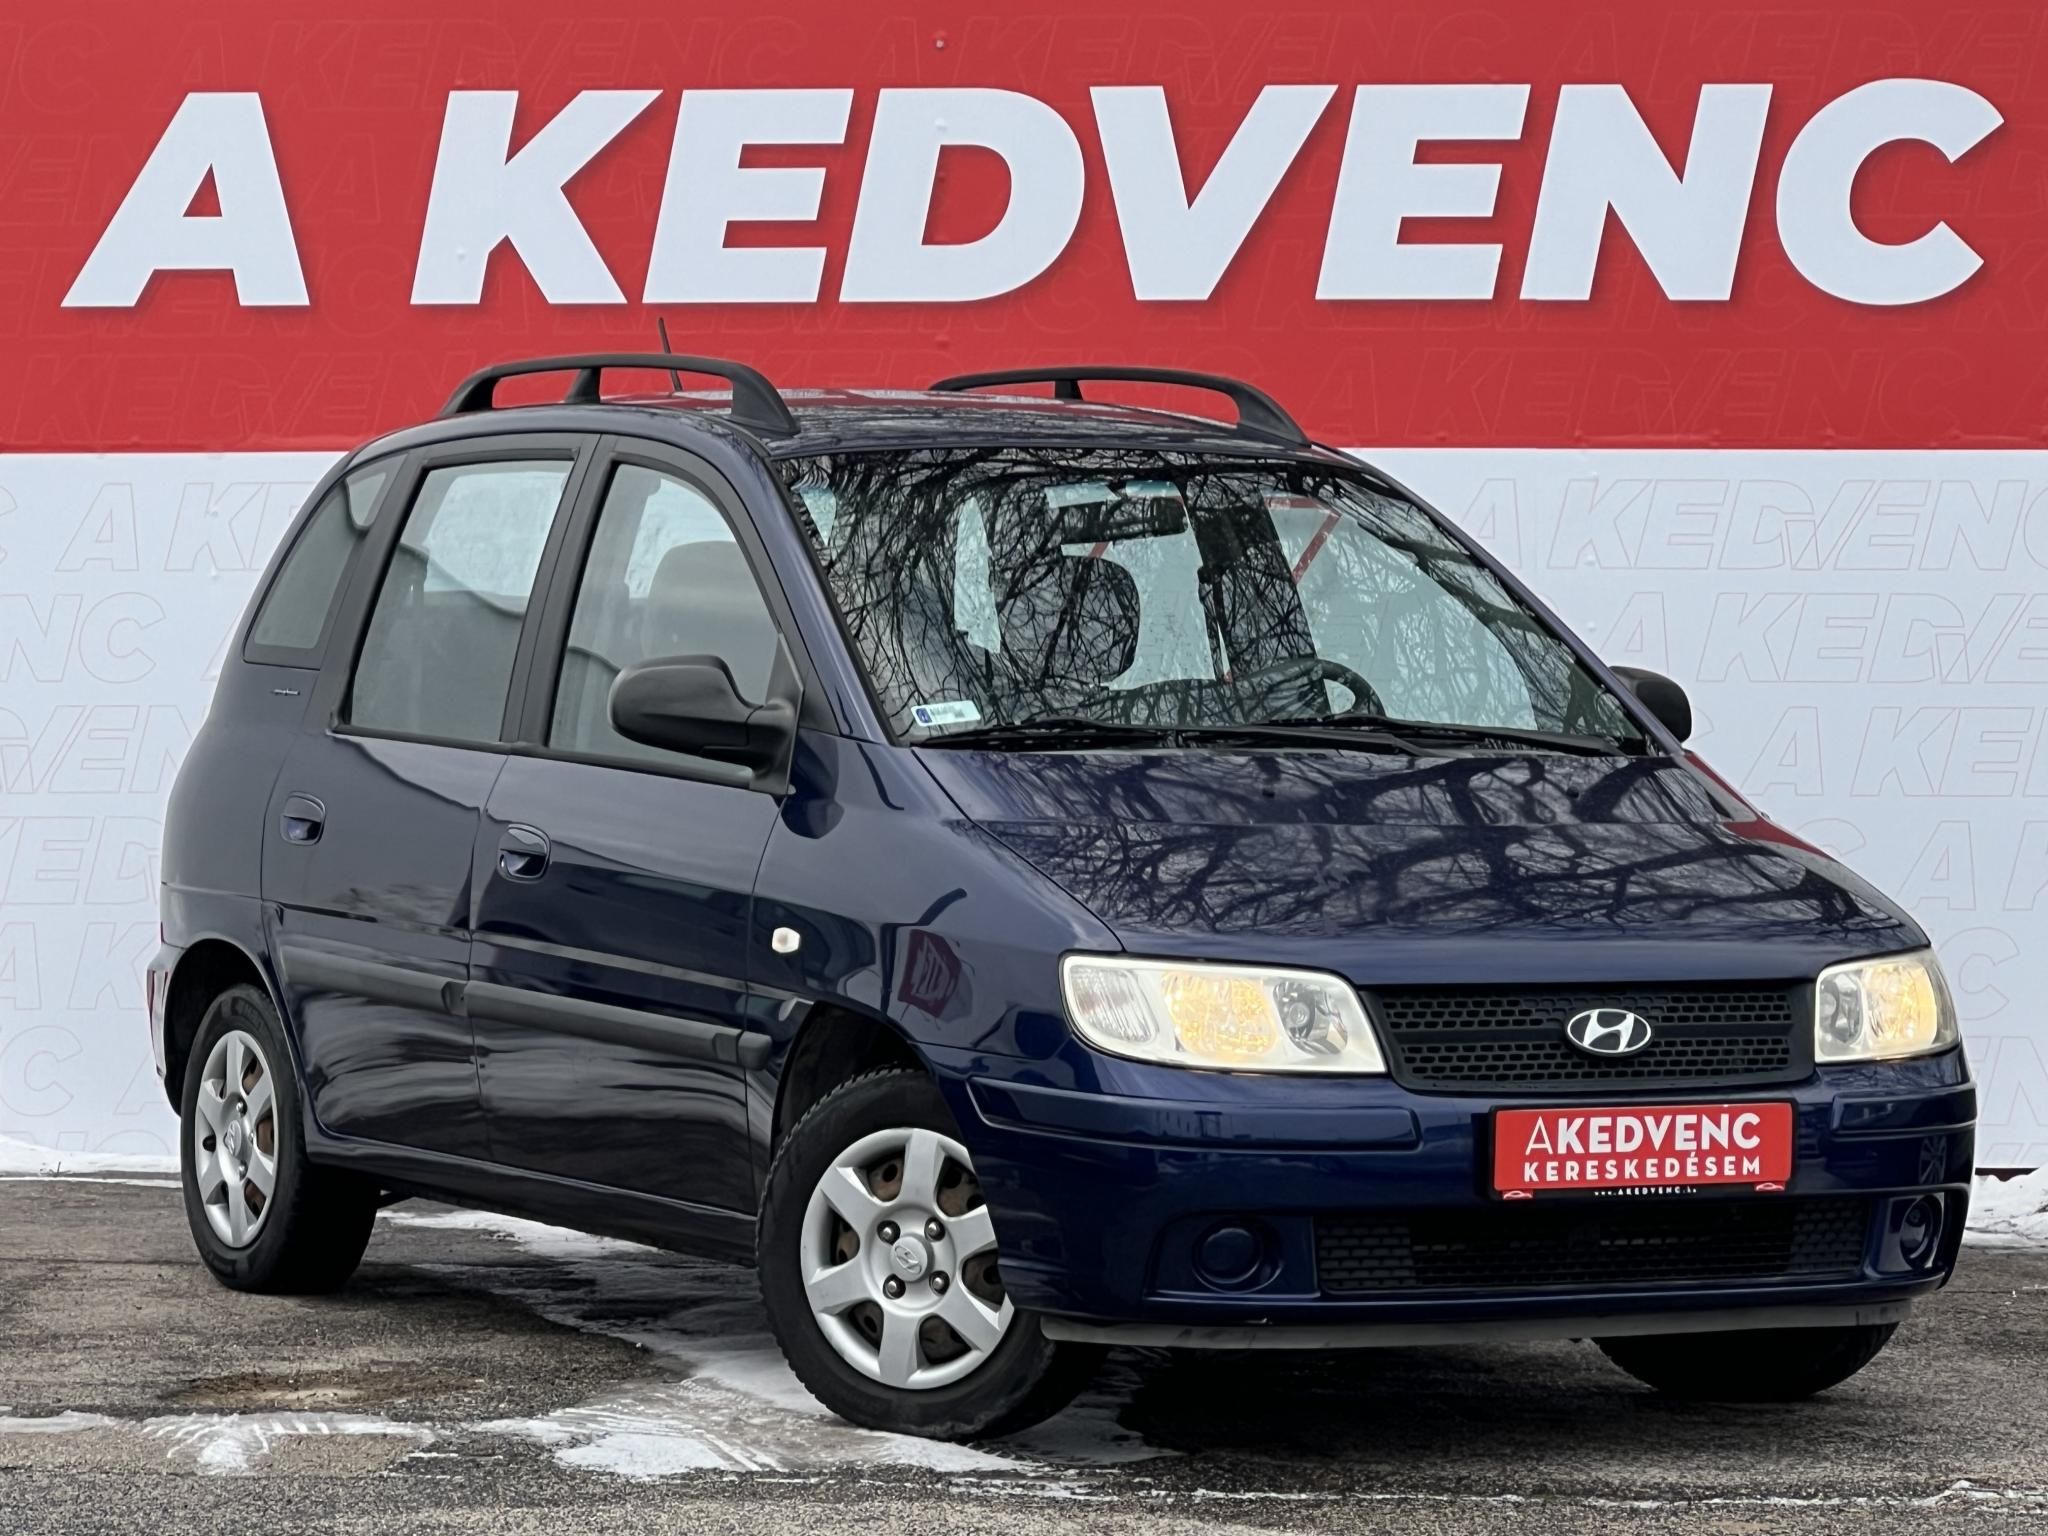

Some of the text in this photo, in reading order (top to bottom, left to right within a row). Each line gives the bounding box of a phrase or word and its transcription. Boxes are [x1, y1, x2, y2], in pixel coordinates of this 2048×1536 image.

[61, 91, 311, 308] A
[410, 78, 2005, 308] KEDVENC
[1523, 1152, 1761, 1182] KERESKEDÉSEM
